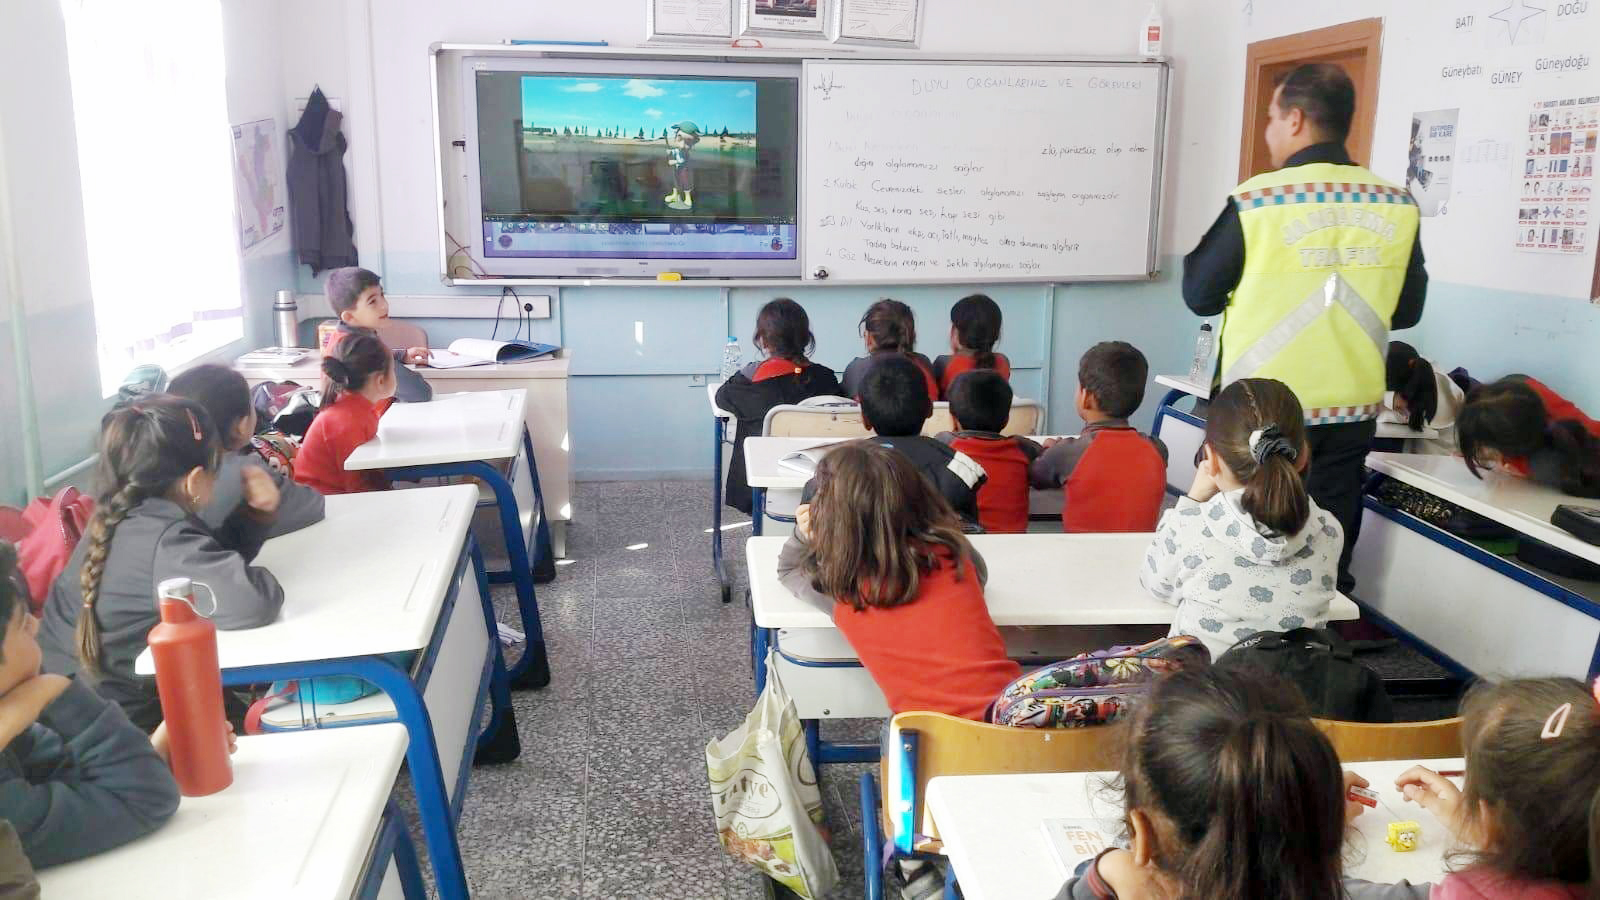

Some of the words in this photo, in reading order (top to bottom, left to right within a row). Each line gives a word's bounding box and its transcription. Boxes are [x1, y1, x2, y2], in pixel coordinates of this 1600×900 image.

[1455, 15, 1474, 29] BATI
[1535, 55, 1590, 72] Güneydoğu
[1441, 65, 1483, 79] Güneybatı
[1490, 70, 1523, 85] GÜNEY
[1065, 830, 1103, 841] FEN
